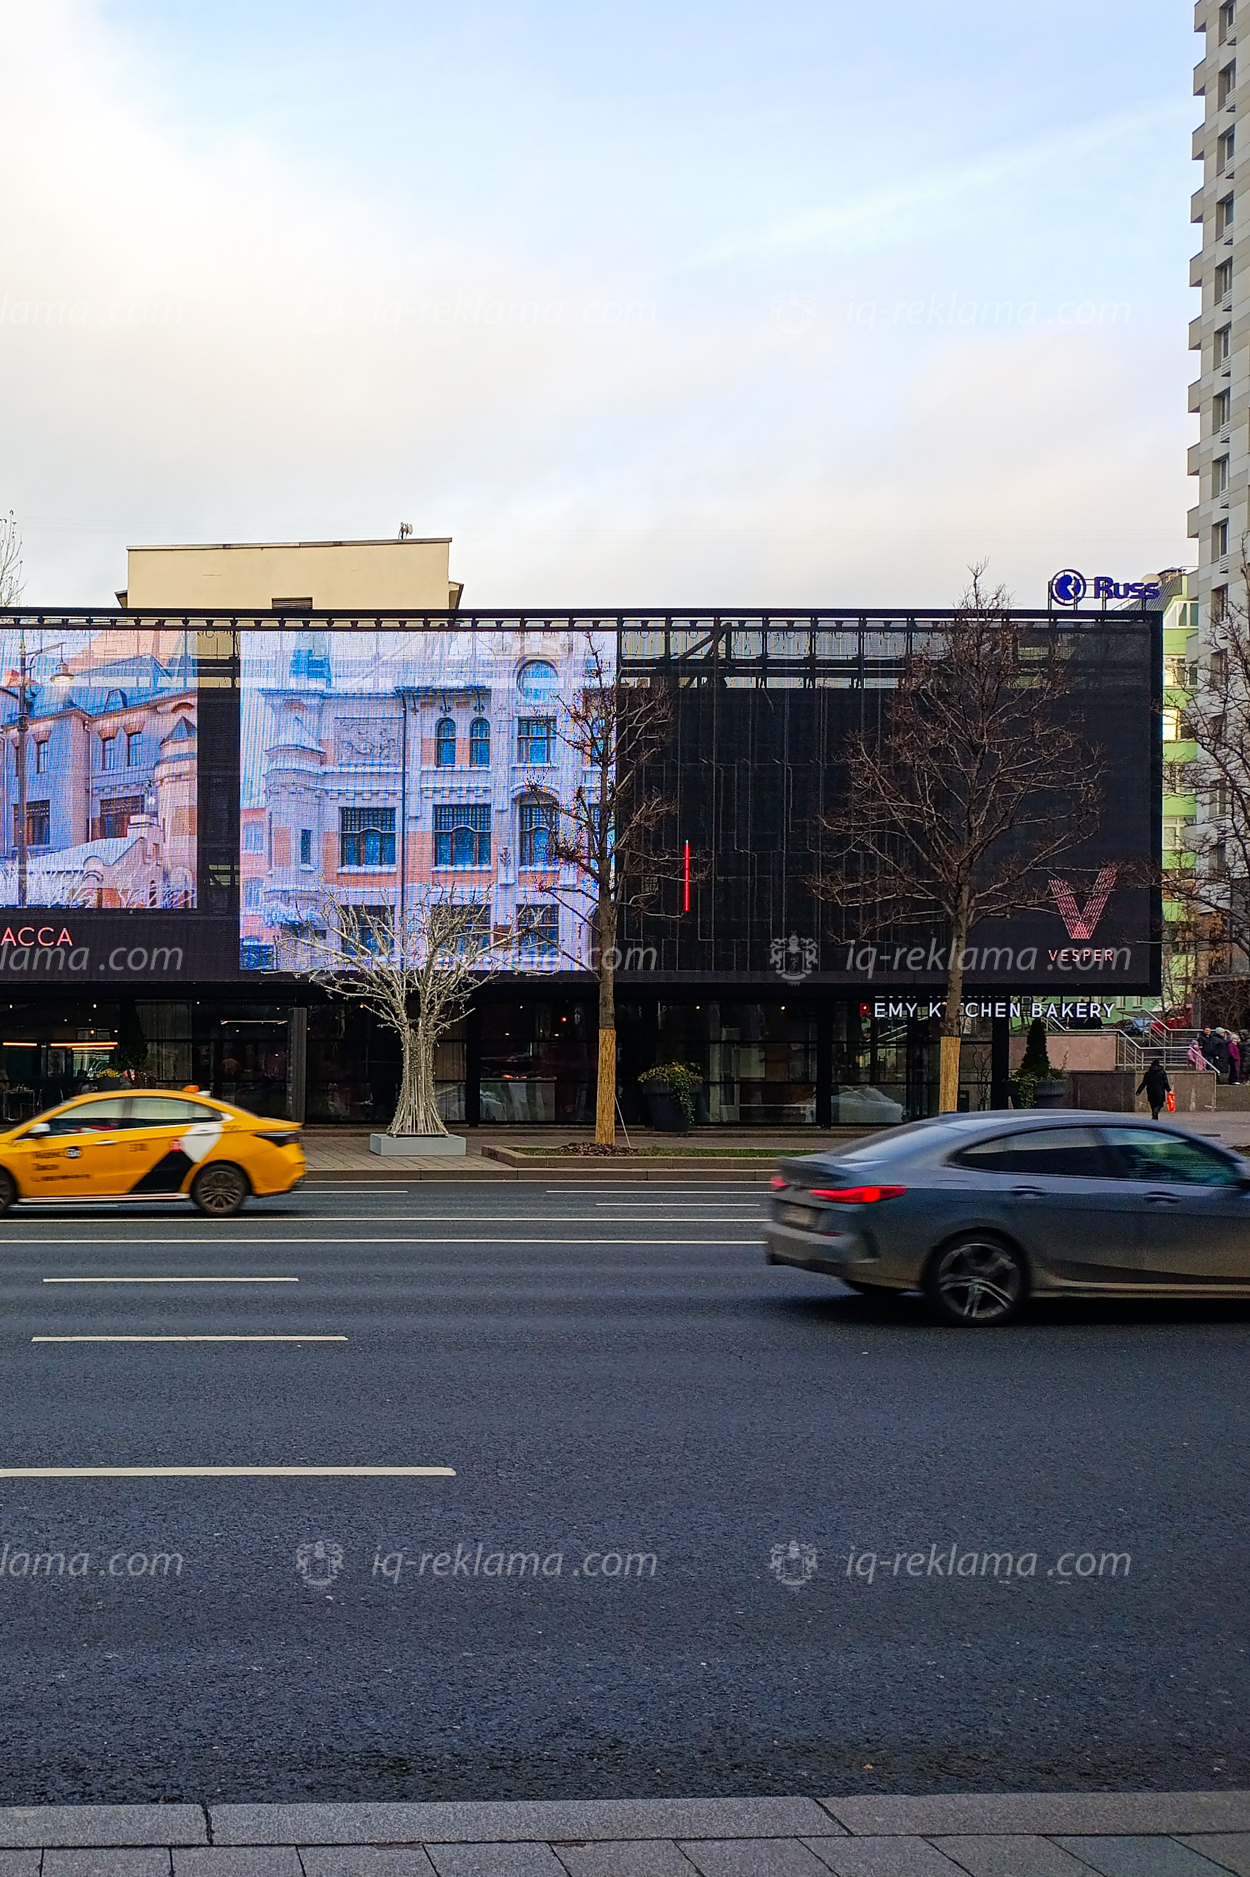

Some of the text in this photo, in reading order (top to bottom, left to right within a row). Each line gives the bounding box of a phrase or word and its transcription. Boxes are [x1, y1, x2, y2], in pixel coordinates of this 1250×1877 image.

[1094, 576, 1161, 599] Russ
[1048, 949, 1114, 962] VESPER
[859, 1002, 1115, 1018] REMY KCHEN BAKERY
